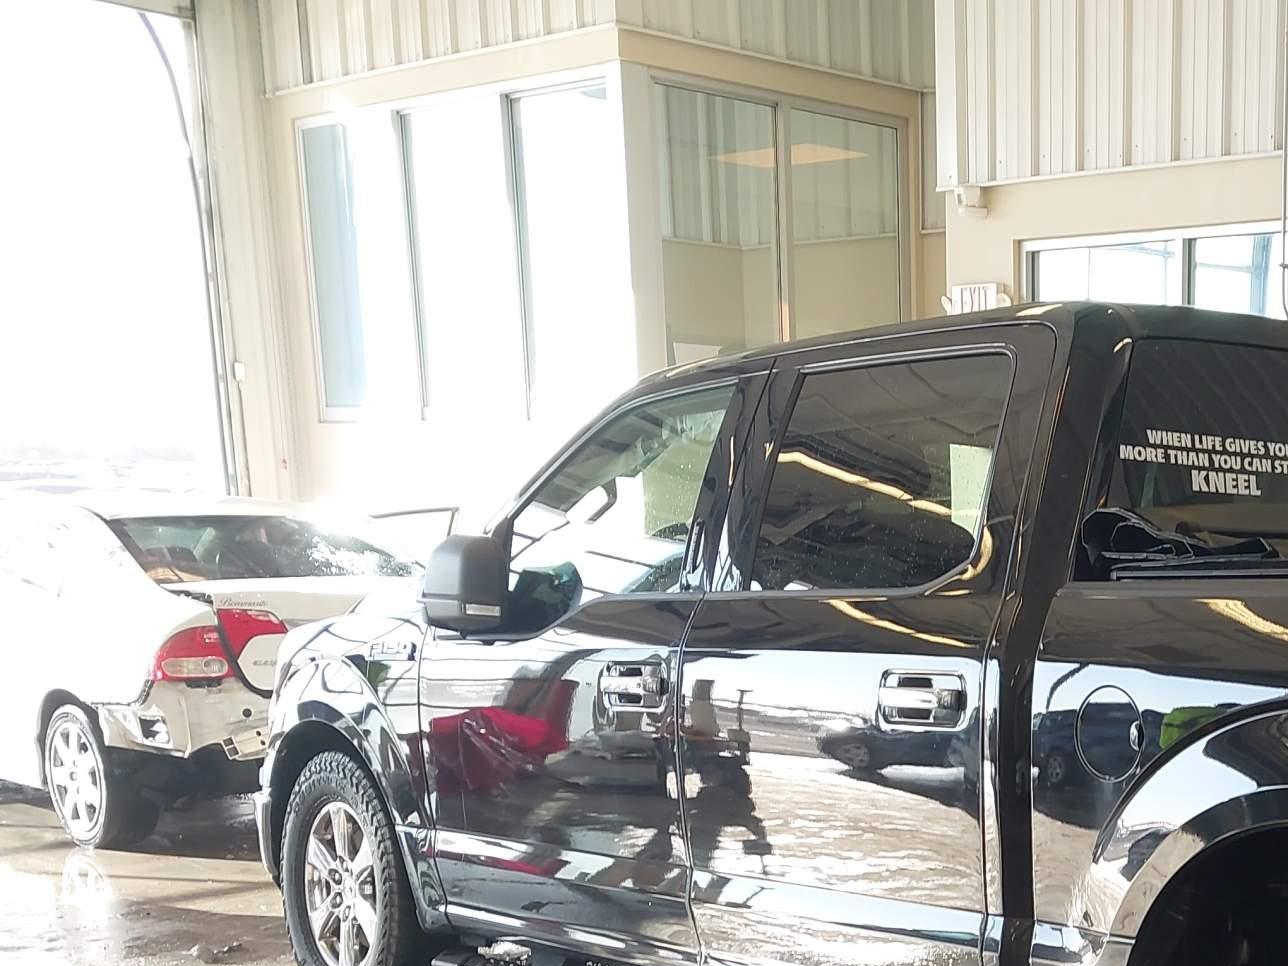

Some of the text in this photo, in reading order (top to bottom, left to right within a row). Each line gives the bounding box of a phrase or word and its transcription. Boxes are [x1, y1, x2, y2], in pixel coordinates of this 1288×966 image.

[960, 285, 991, 312] EXIT
[1146, 429, 1192, 448] WHEN
[1194, 435, 1223, 451] LIFE
[1225, 438, 1265, 456] GIVES
[1119, 444, 1166, 464] MORE
[1167, 450, 1210, 468] THAN
[1211, 454, 1242, 471] YOU
[1243, 456, 1272, 473] CAN
[1191, 469, 1262, 496] KNEEL
